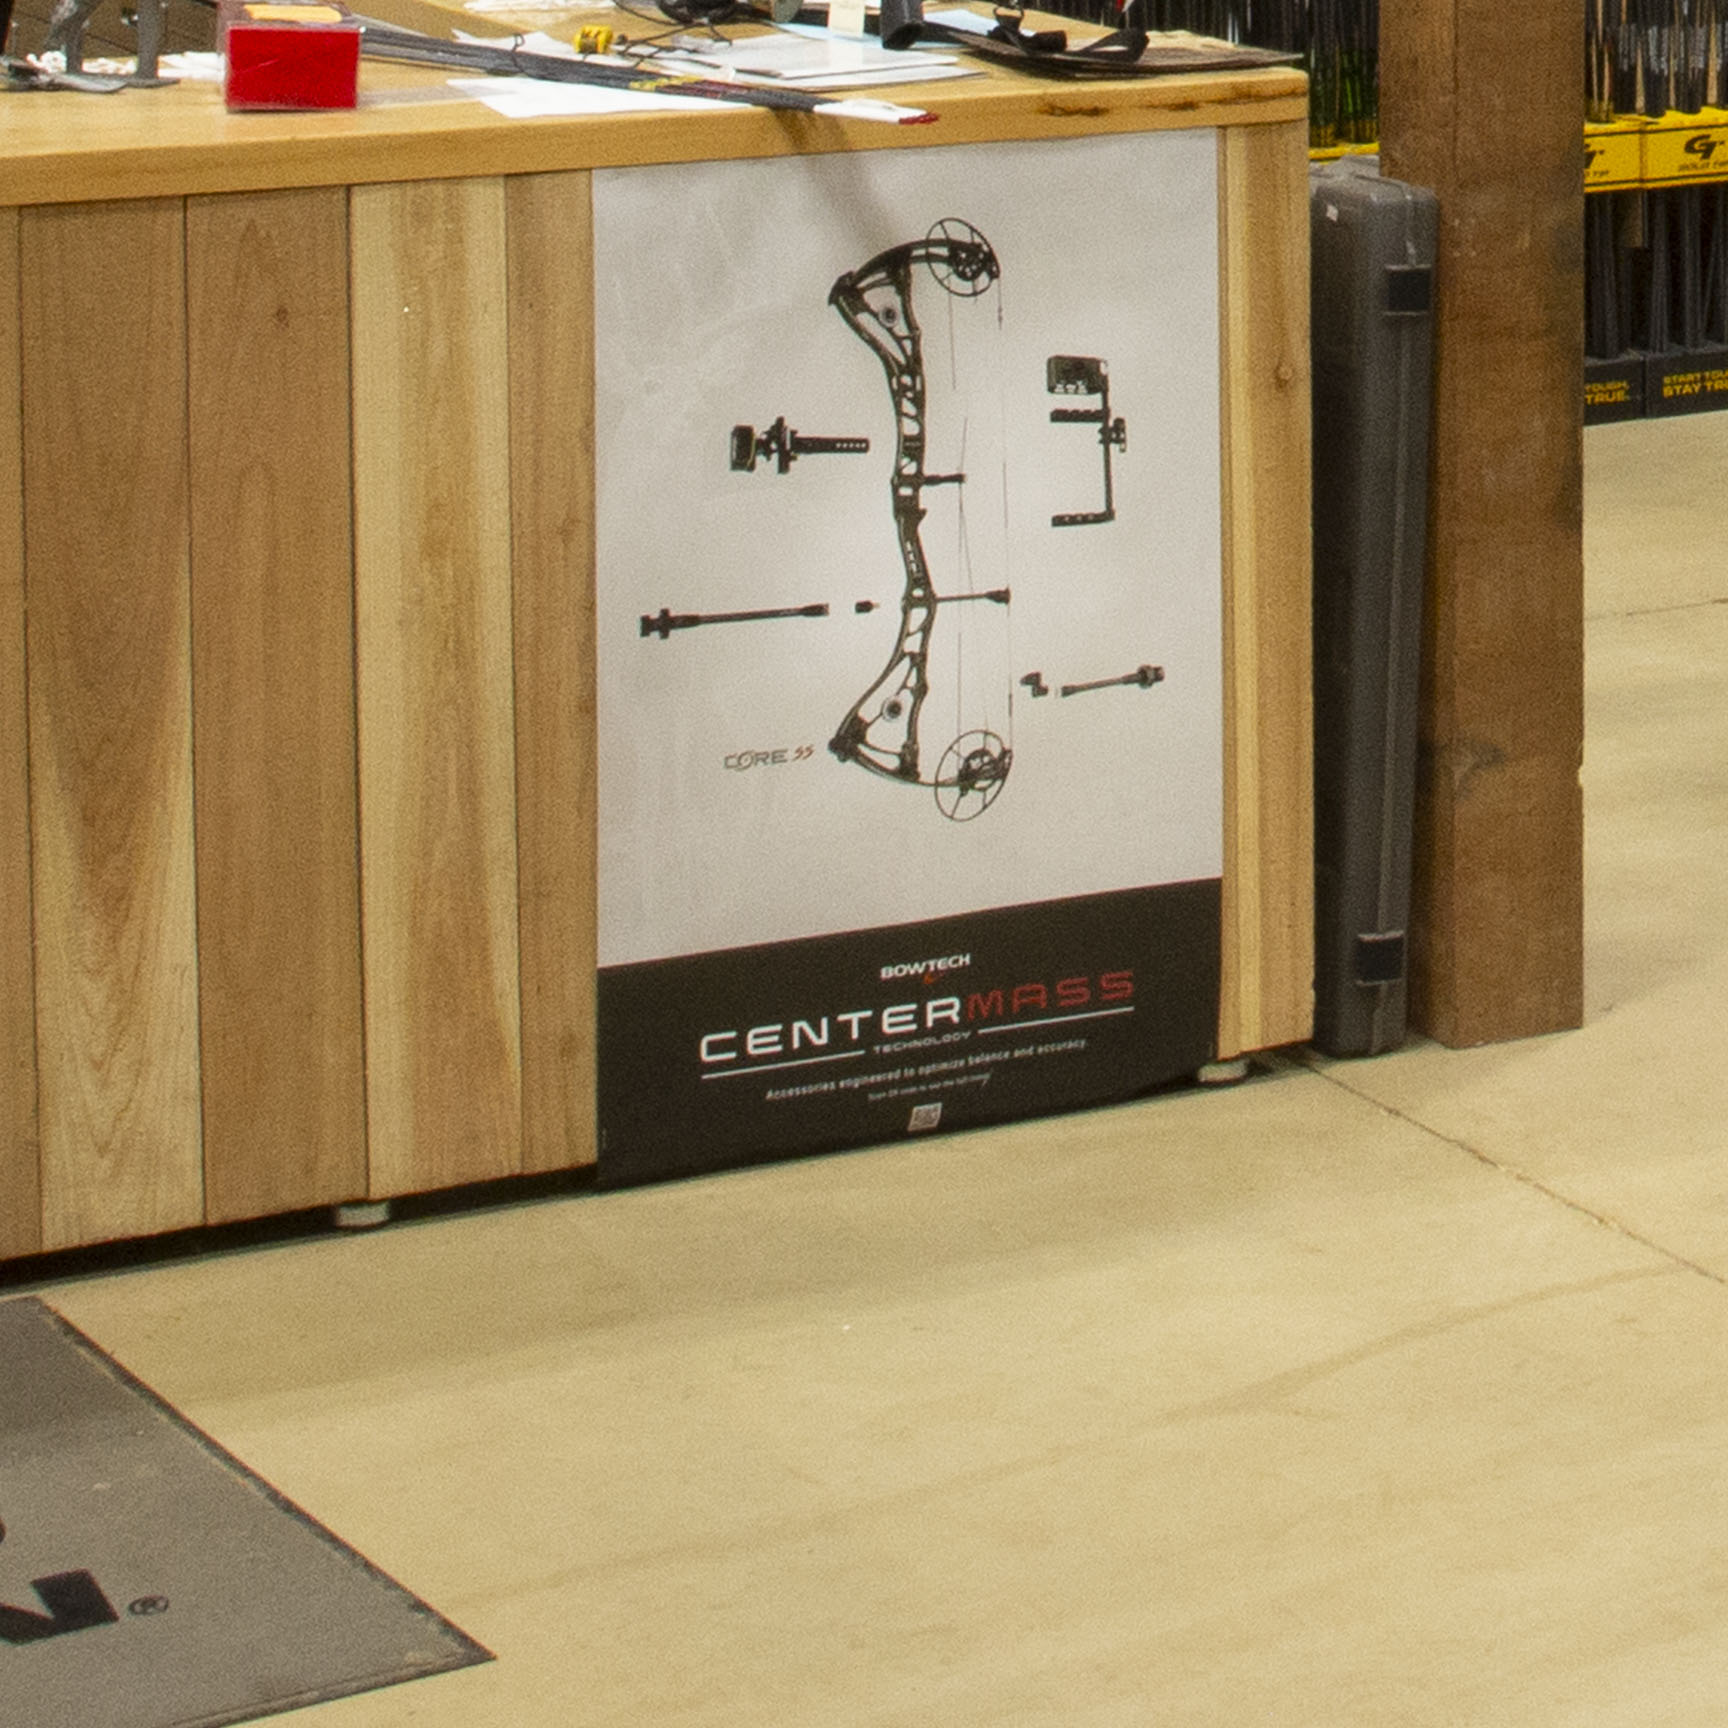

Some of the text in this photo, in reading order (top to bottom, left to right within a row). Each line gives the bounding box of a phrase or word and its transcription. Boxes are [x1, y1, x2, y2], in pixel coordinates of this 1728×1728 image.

[1662, 383, 1703, 399] STAY
[724, 749, 788, 772] CORE
[880, 953, 972, 981] BOWTECH
[700, 971, 1135, 1063] CENTERMASS
[873, 1031, 972, 1055] TECHNOLOGY
[766, 1081, 835, 1100] Accessories
[839, 1068, 901, 1089] engineered
[968, 1050, 1010, 1065] balance
[1013, 1046, 1034, 1058] and
